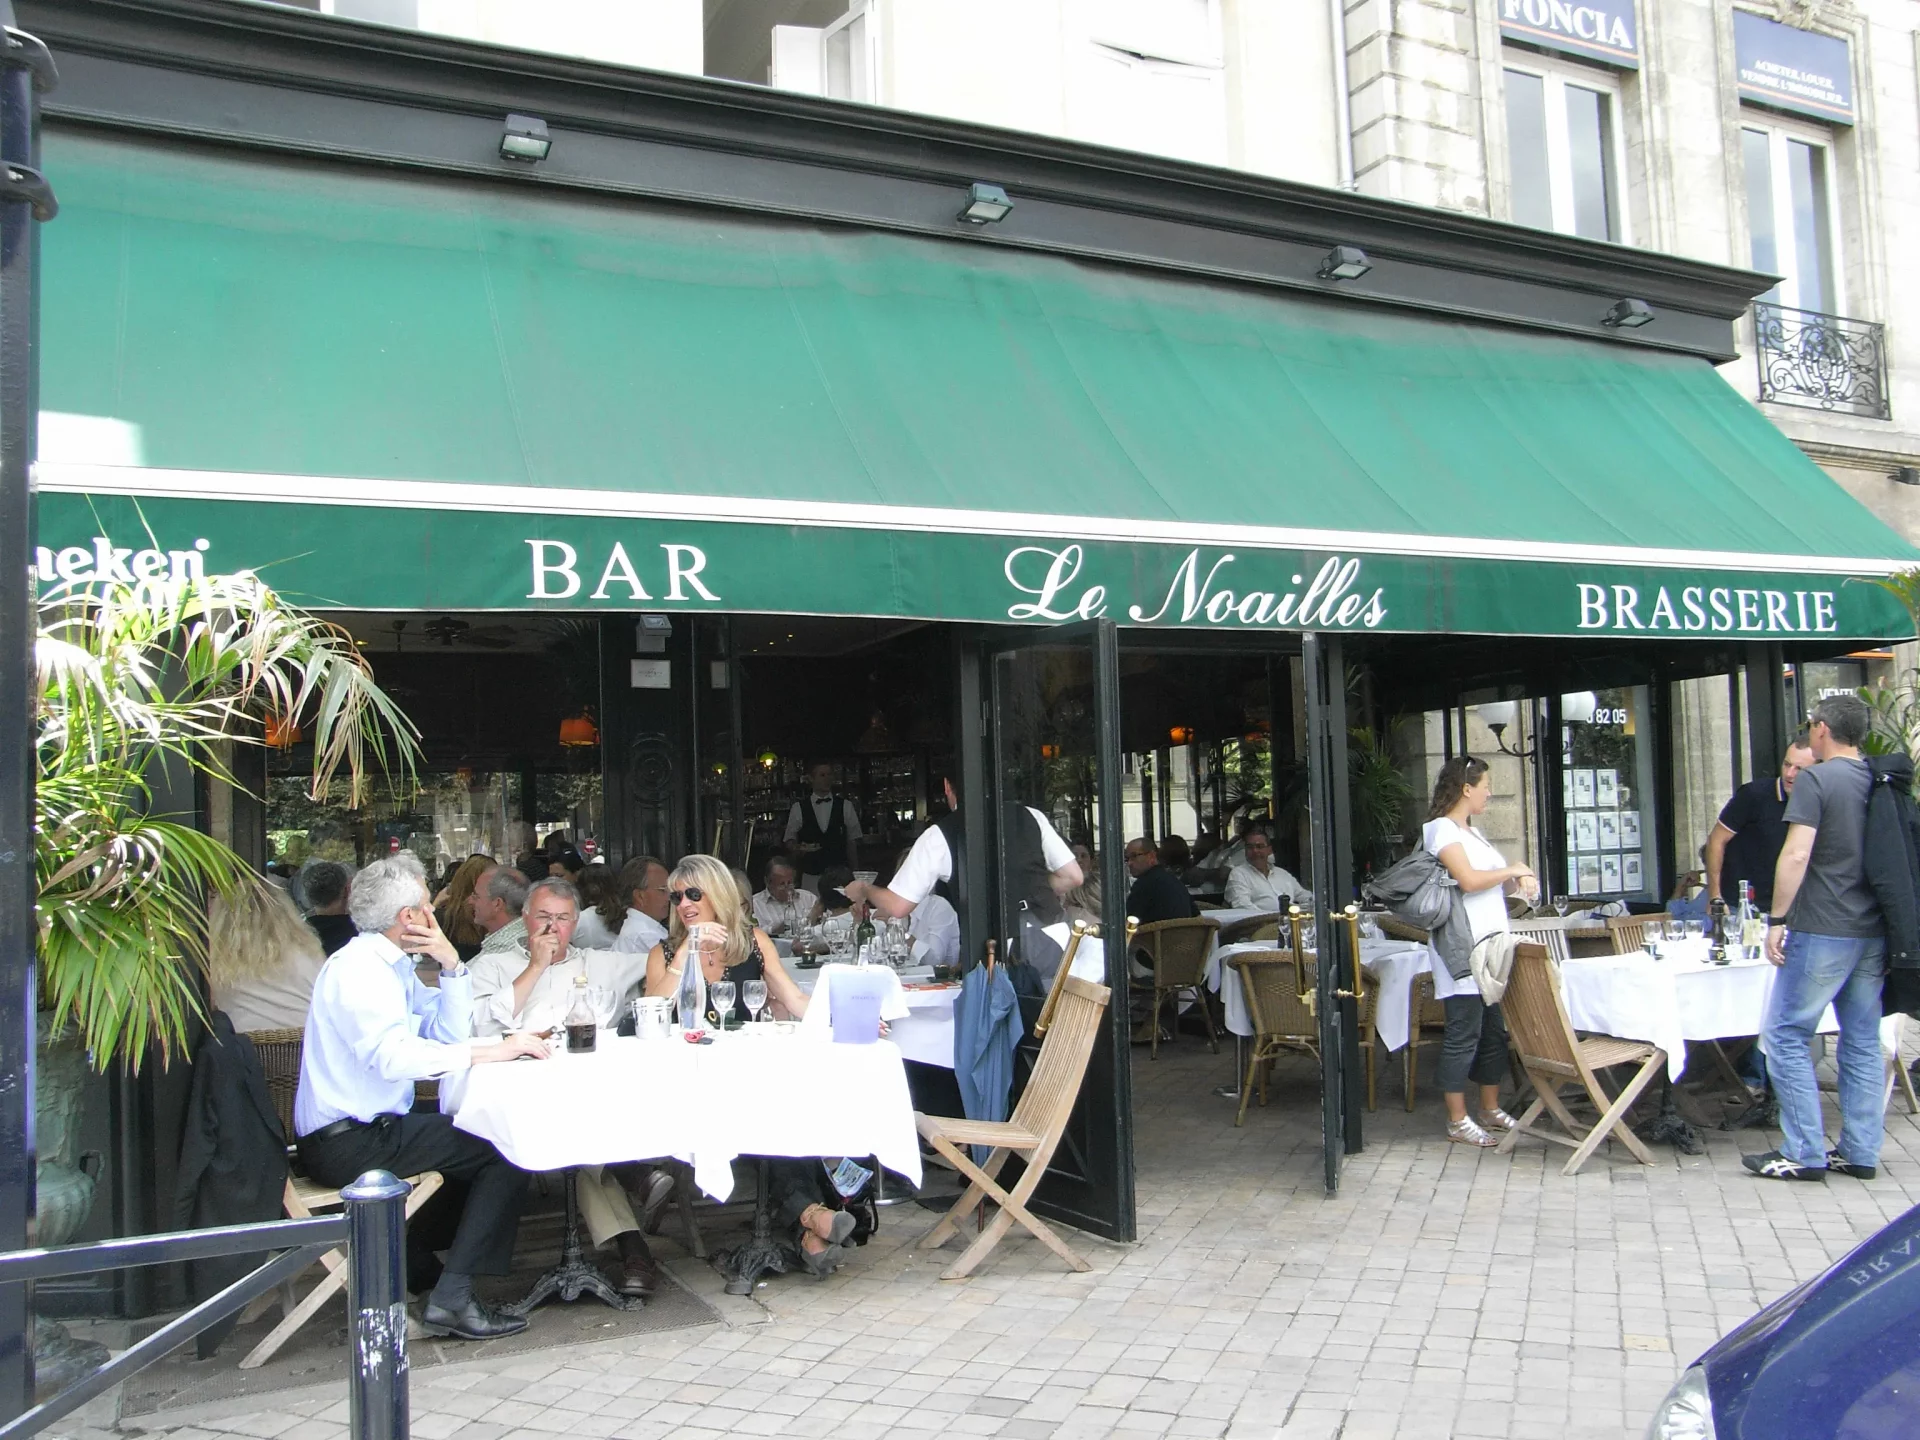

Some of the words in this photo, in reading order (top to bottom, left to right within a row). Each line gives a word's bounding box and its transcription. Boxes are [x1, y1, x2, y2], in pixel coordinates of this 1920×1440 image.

[1503, 0, 1633, 49] FONCIA
[524, 539, 721, 601] BAR
[1004, 544, 1107, 620] Le
[1128, 547, 1388, 627] Noailles
[1576, 583, 1838, 632] BRASSERIE
[1595, 708, 1610, 724] 82
[1612, 708, 1627, 724] 05
